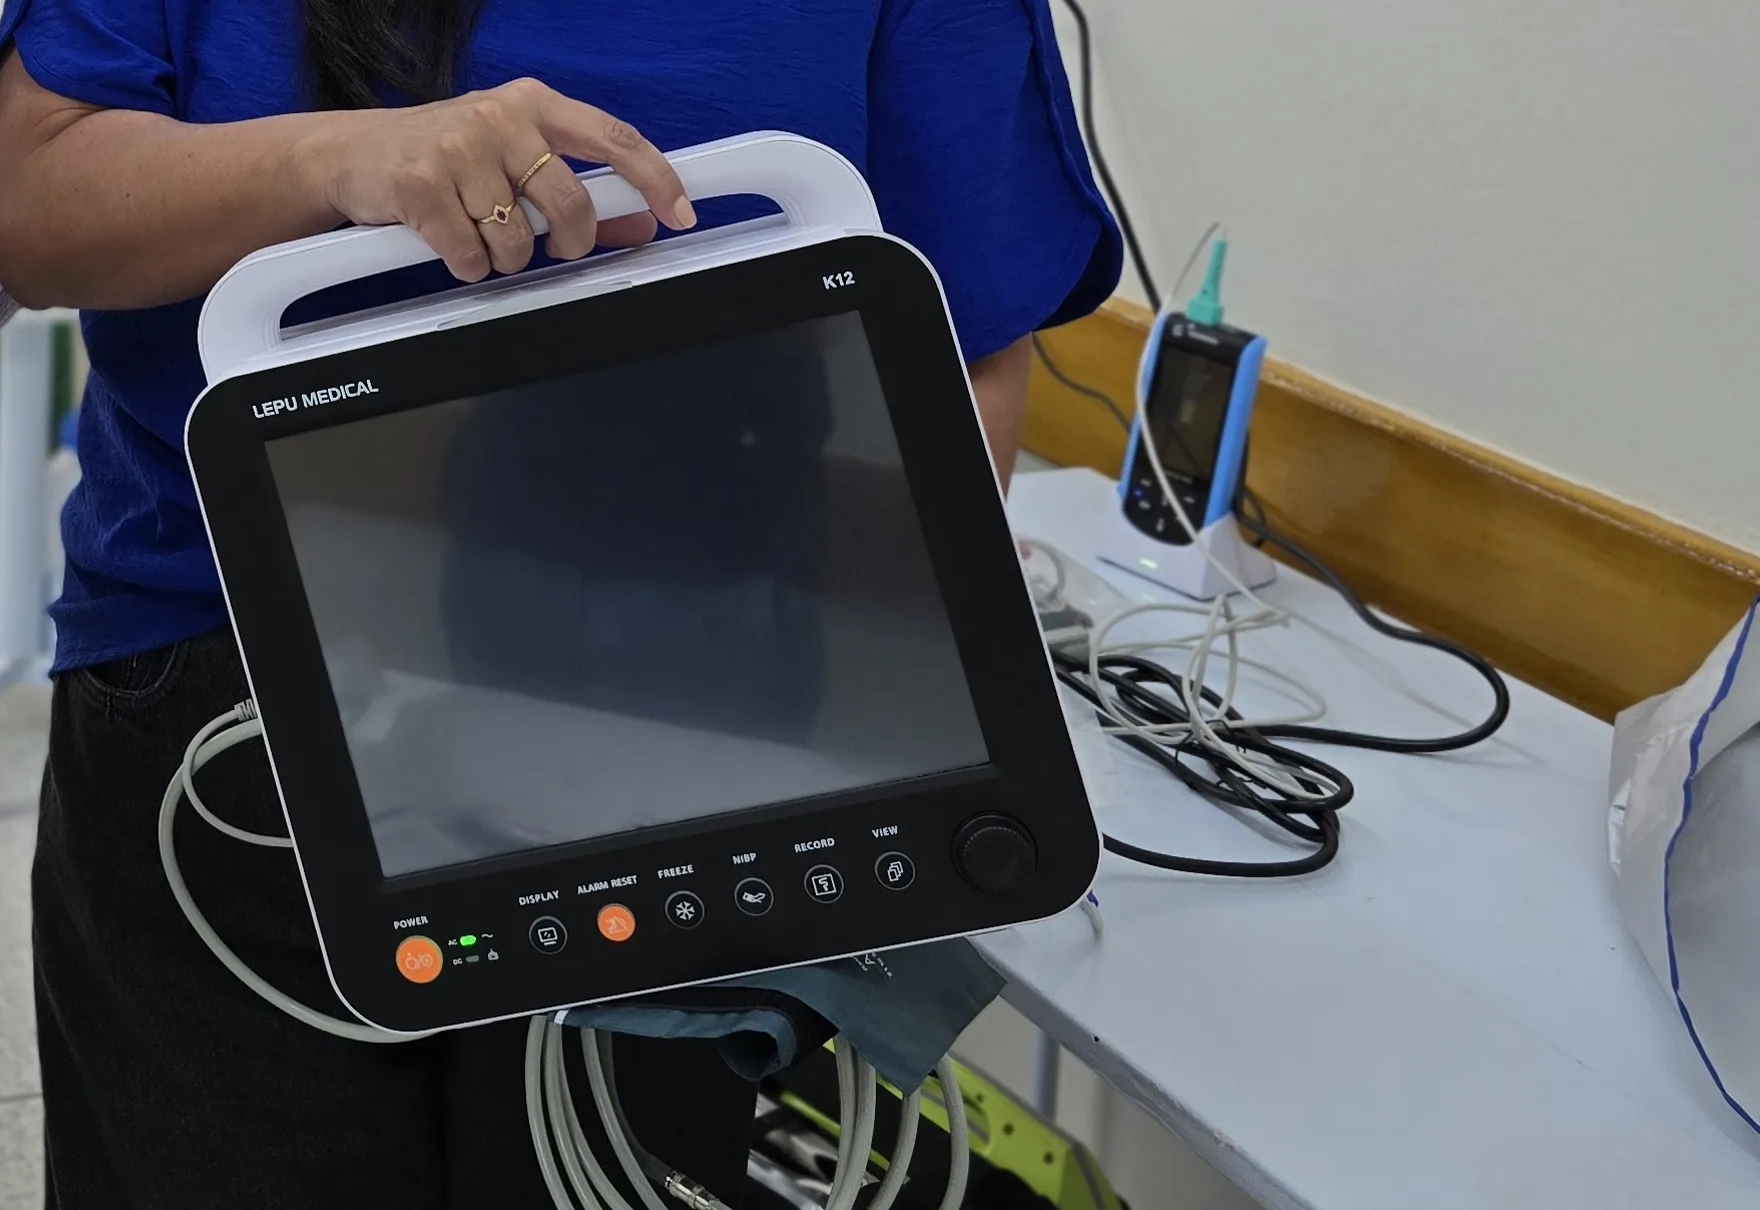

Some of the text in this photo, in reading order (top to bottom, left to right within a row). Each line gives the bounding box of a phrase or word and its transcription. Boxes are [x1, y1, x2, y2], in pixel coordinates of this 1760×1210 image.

[823, 271, 855, 289] K12
[252, 379, 379, 418] LEPU MEDICAL
[872, 825, 898, 838] VIEW
[794, 837, 835, 853] RECORD
[732, 852, 757, 864] NIBP
[657, 864, 694, 879] FREEZE
[577, 875, 638, 895] ALARM RESET
[519, 890, 560, 906] DISPLAY
[393, 915, 428, 930] POWER
[452, 957, 463, 965] DC
